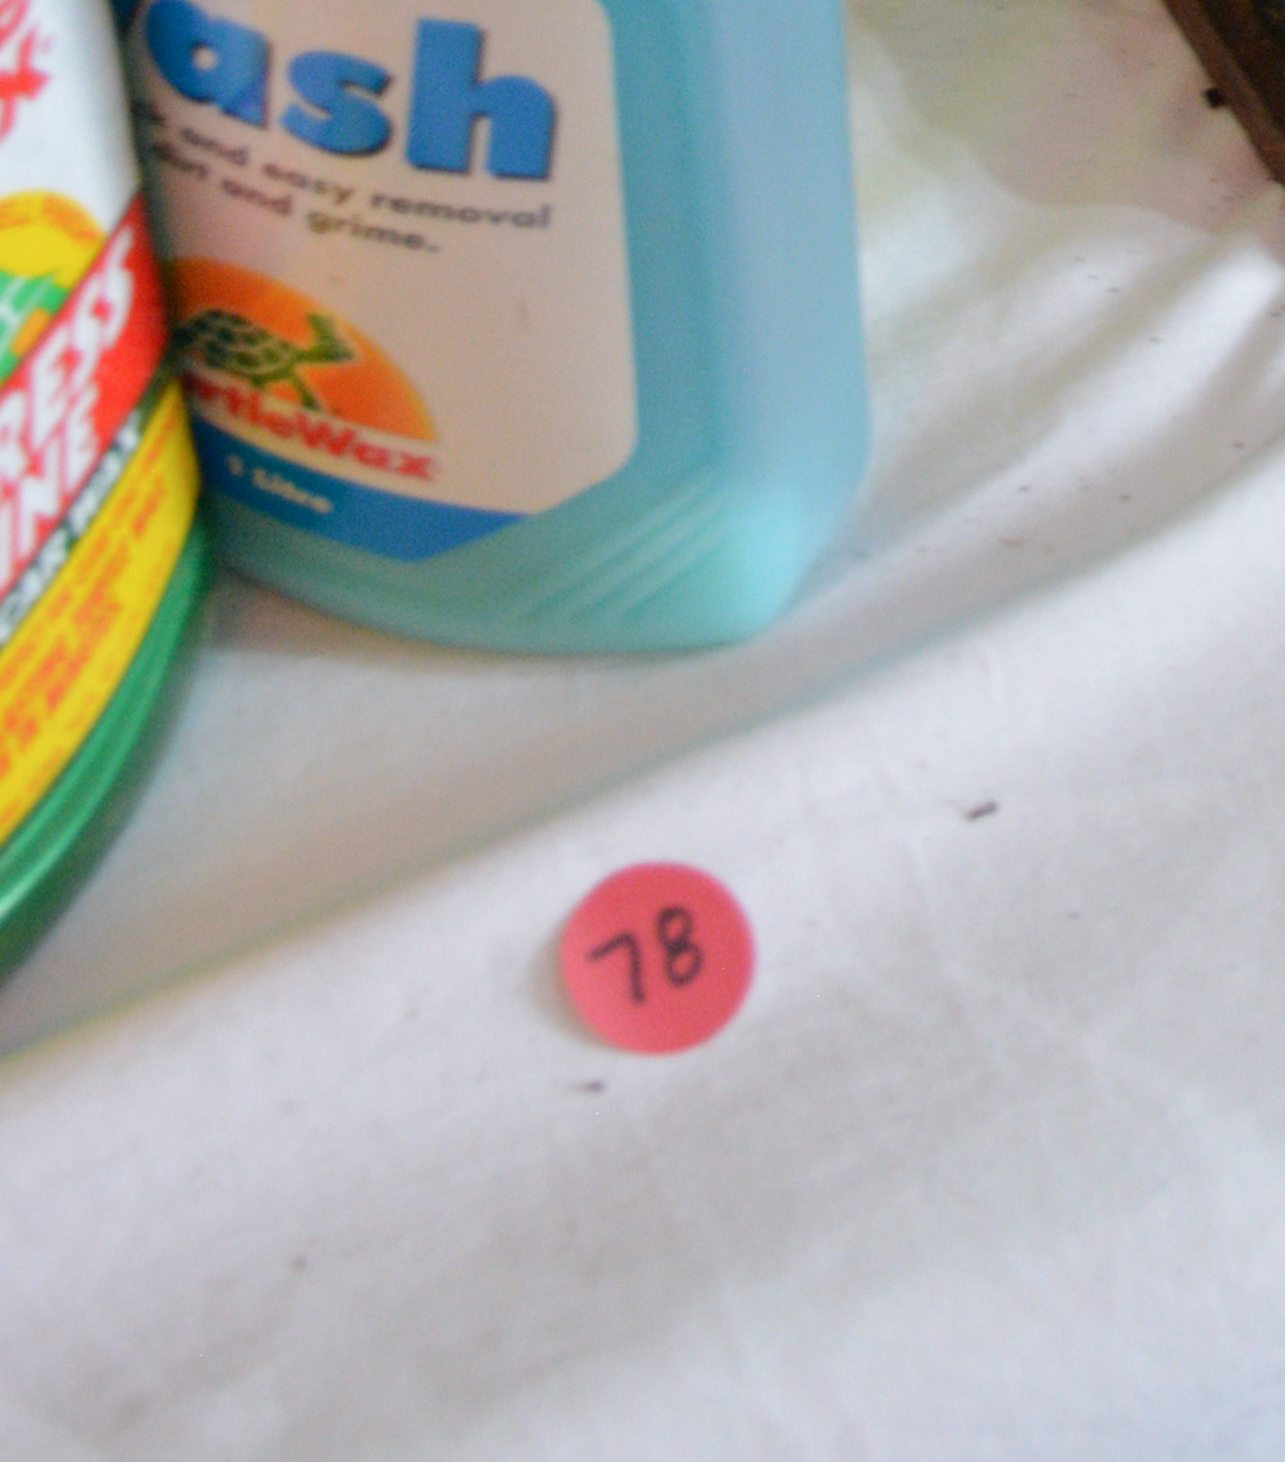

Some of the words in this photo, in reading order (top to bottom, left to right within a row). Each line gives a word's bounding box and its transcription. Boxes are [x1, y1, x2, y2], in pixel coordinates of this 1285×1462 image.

[181, 128, 249, 168] and
[261, 161, 353, 207] easy
[369, 191, 553, 230] removal
[220, 177, 294, 216] and
[586, 905, 704, 1003] 78
